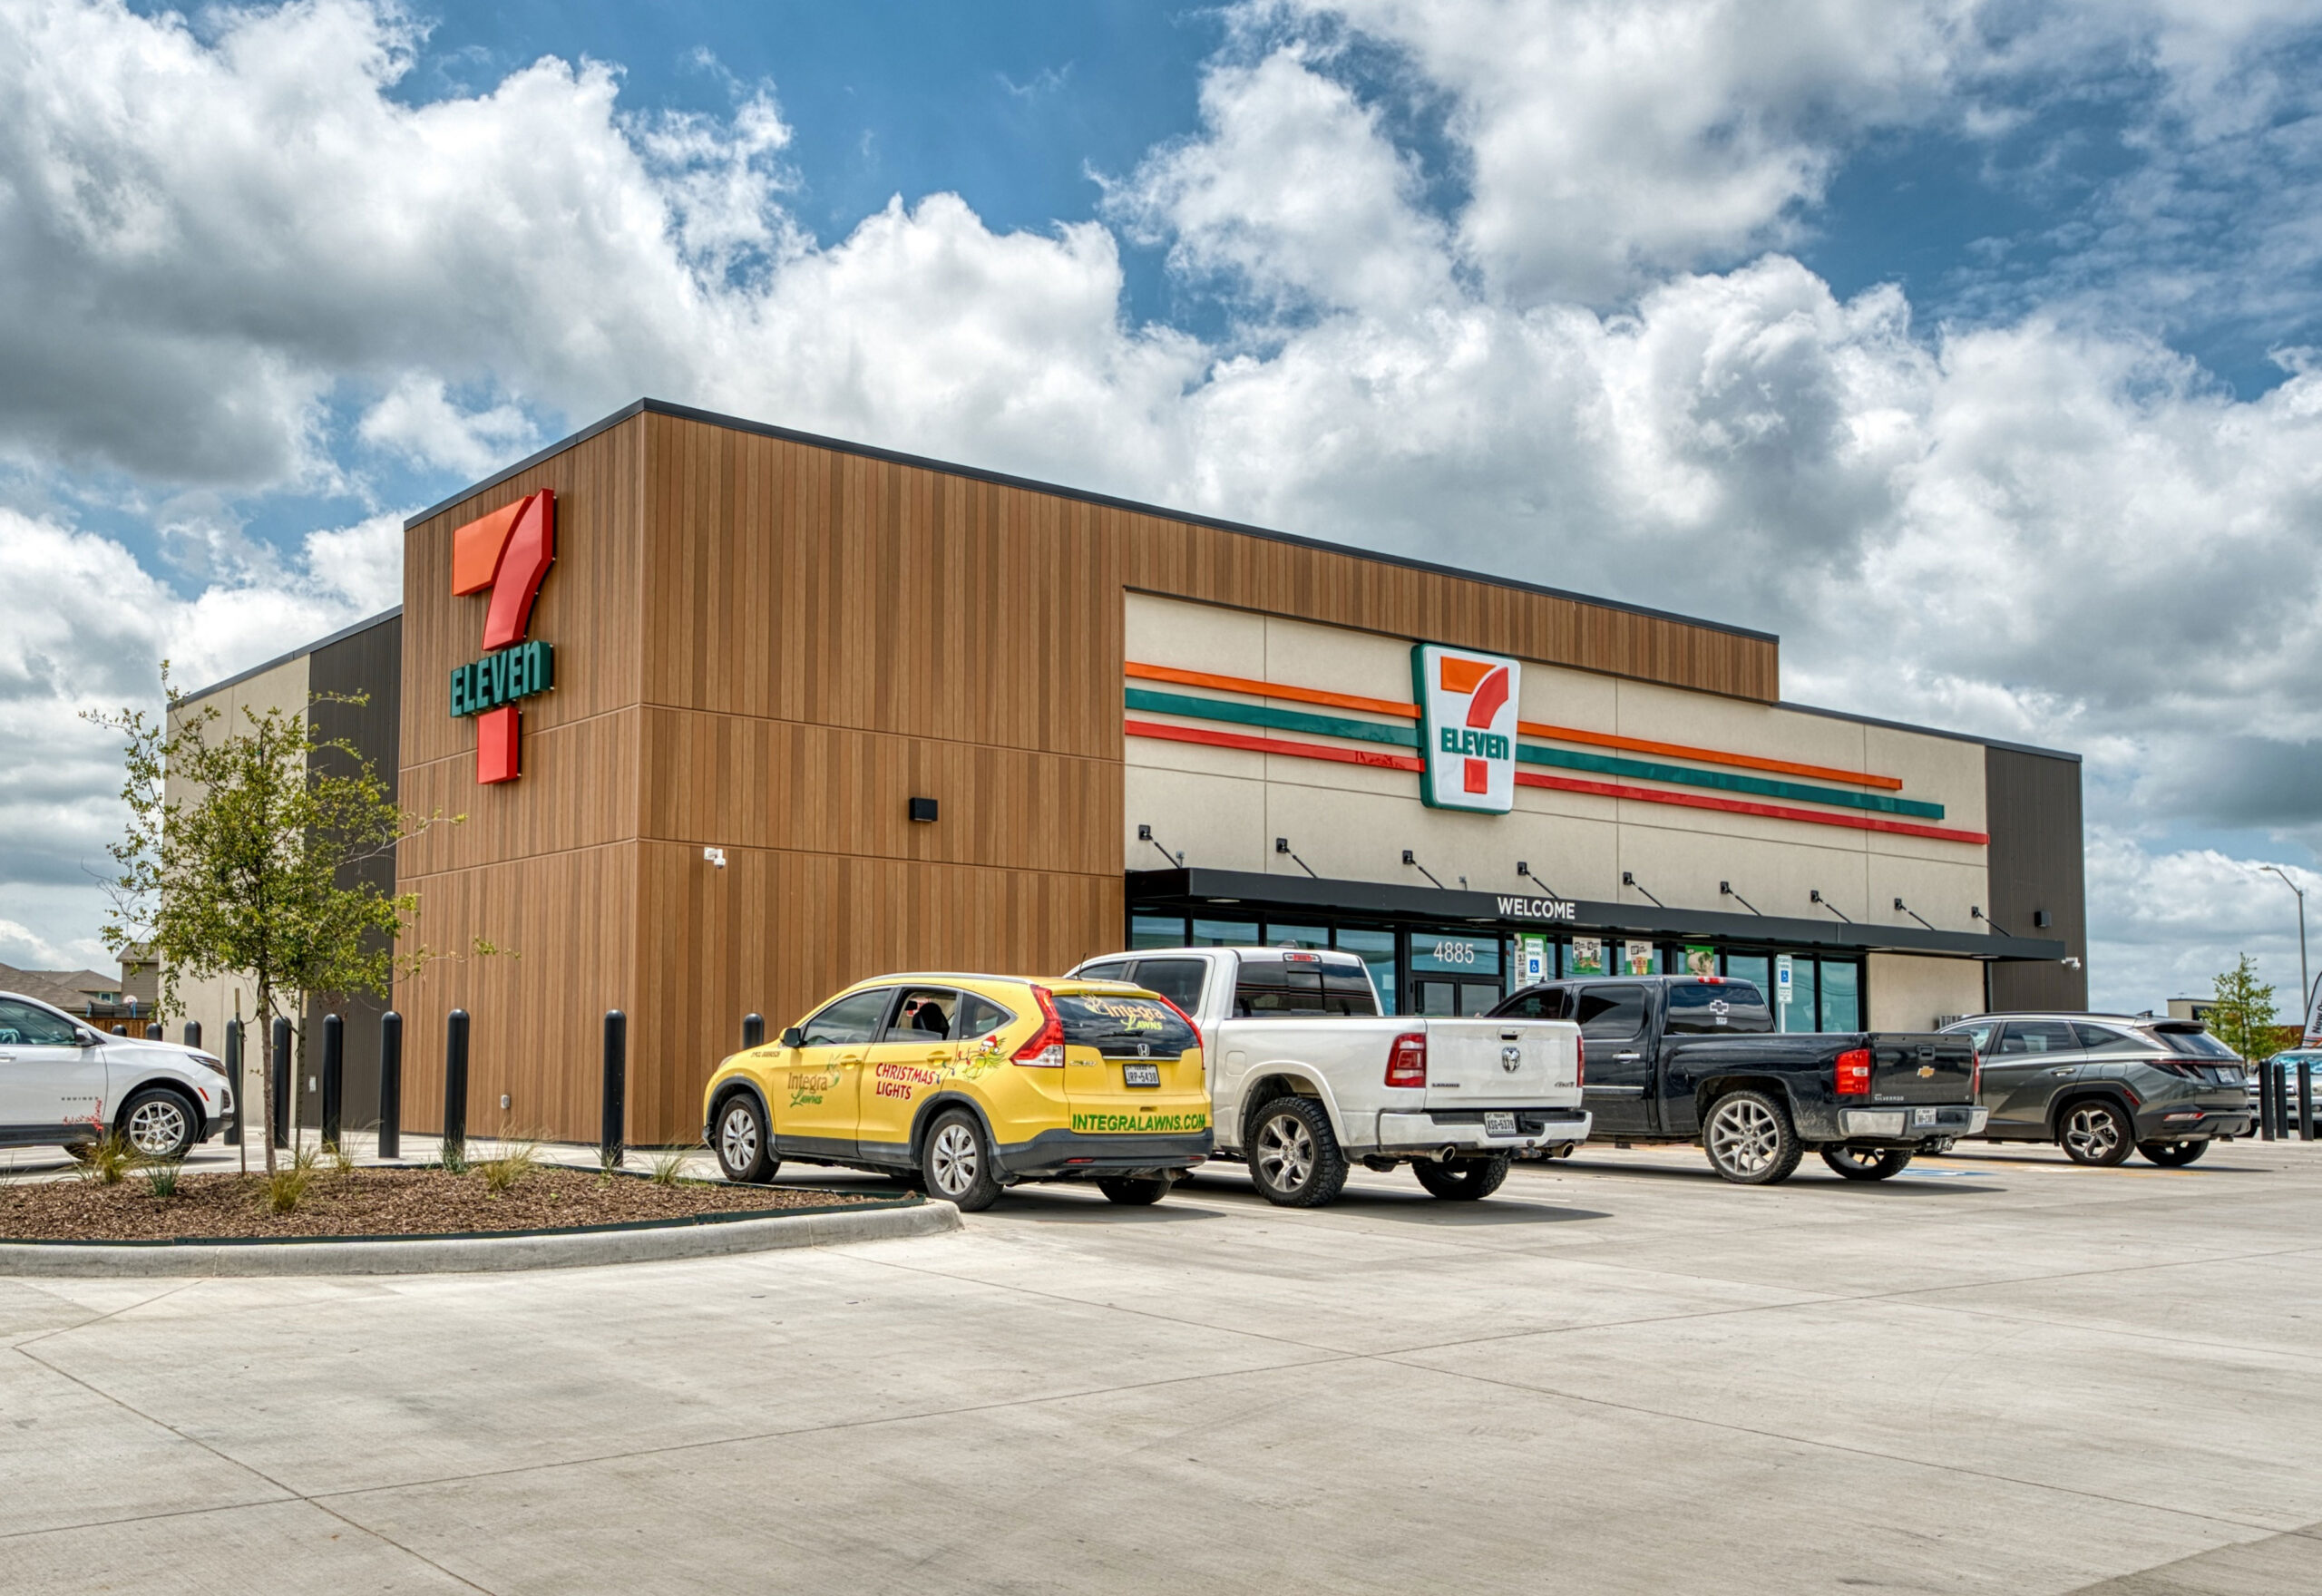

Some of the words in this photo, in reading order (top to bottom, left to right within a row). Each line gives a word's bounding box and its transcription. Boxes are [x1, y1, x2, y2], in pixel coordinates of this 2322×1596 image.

[1497, 896, 1576, 920] WELCOME
[1433, 941, 1474, 964] 4885
[1103, 1004, 1166, 1021] Integra
[787, 1072, 827, 1094] Integra
[875, 1062, 936, 1085] CHRISTMAS
[875, 1081, 912, 1100] LIGHTS
[1072, 1113, 1206, 1132] INTEGRALAWNS.COM
